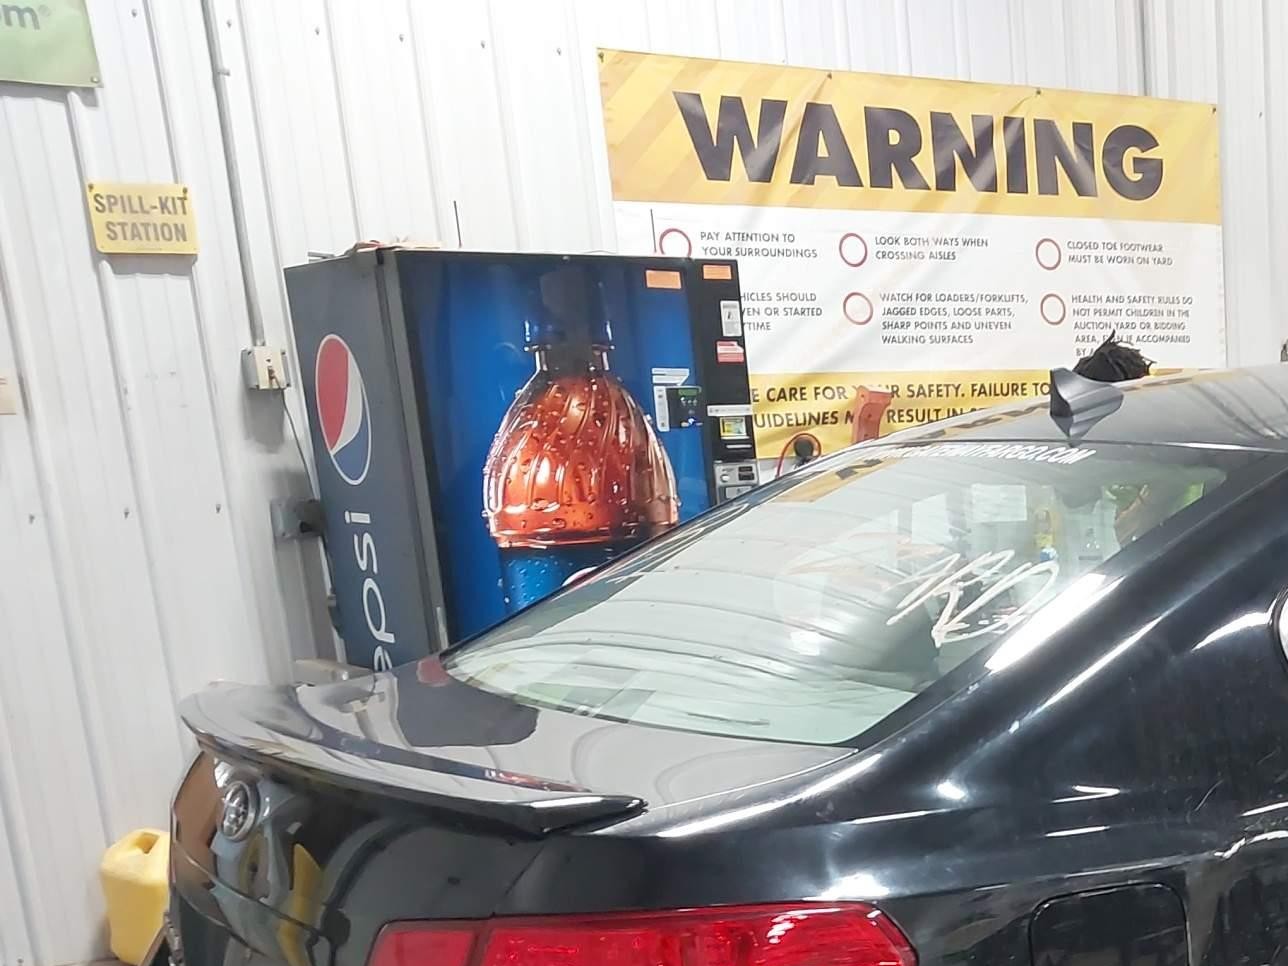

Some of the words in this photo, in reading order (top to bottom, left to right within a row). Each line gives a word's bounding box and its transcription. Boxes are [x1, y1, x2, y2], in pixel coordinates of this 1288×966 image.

[672, 91, 1164, 200] WARNING
[93, 193, 187, 215] SPILL-KIT
[105, 221, 188, 242] STATION
[700, 231, 720, 241] PAY
[724, 232, 779, 243] ATTENTION
[782, 233, 795, 243] TO
[875, 236, 901, 246] LOOK
[903, 237, 929, 247] BOTH
[933, 237, 960, 247] WAYS
[961, 237, 989, 247] WHEN
[1067, 241, 1099, 251] CLOSED
[1101, 241, 1118, 251] TOE
[1120, 242, 1164, 252] FOOTWEAR
[702, 246, 732, 257] YOUR
[735, 246, 818, 258] SURROUNDINGS
[875, 250, 926, 260] CROSSING
[928, 251, 957, 261] AISLES
[1068, 255, 1091, 264] MUST
[1094, 255, 1104, 264] BE
[1106, 255, 1134, 265] WORN
[1136, 256, 1150, 266] ON
[1151, 257, 1173, 266] YARD
[740, 292, 772, 302] HICLES
[776, 292, 817, 302] SHOULD
[879, 292, 912, 302] WATCH
[915, 293, 933, 302] FOR
[1071, 295, 1103, 304] HEALTH
[1105, 295, 1125, 304] AND
[1127, 296, 1155, 304] SAFETY
[764, 307, 780, 316] OR
[783, 307, 823, 317] STARTED
[881, 307, 917, 317] JAGGED
[919, 307, 950, 317] EDGES,
[953, 307, 982, 317] LOOSE
[1072, 308, 1090, 317] NOT
[1093, 308, 1123, 317] PERMIT
[1125, 308, 1164, 317] CHILDREN
[881, 321, 911, 330] SHARP
[914, 321, 948, 331] POINTS
[950, 321, 972, 331] AND
[974, 321, 1012, 331] UNEVEN
[1074, 321, 1112, 330] AUCTION
[1115, 321, 1137, 330] YARD
[881, 335, 926, 345] WALKING
[929, 335, 974, 345] SURFACES
[766, 387, 807, 402] CARE
[814, 385, 849, 400] FOR
[906, 383, 965, 398] SAFETY.
[971, 382, 1028, 397] FAILURE
[1032, 382, 1051, 396] TO
[754, 411, 838, 428] UIDELINES
[887, 407, 942, 423] RESULT
